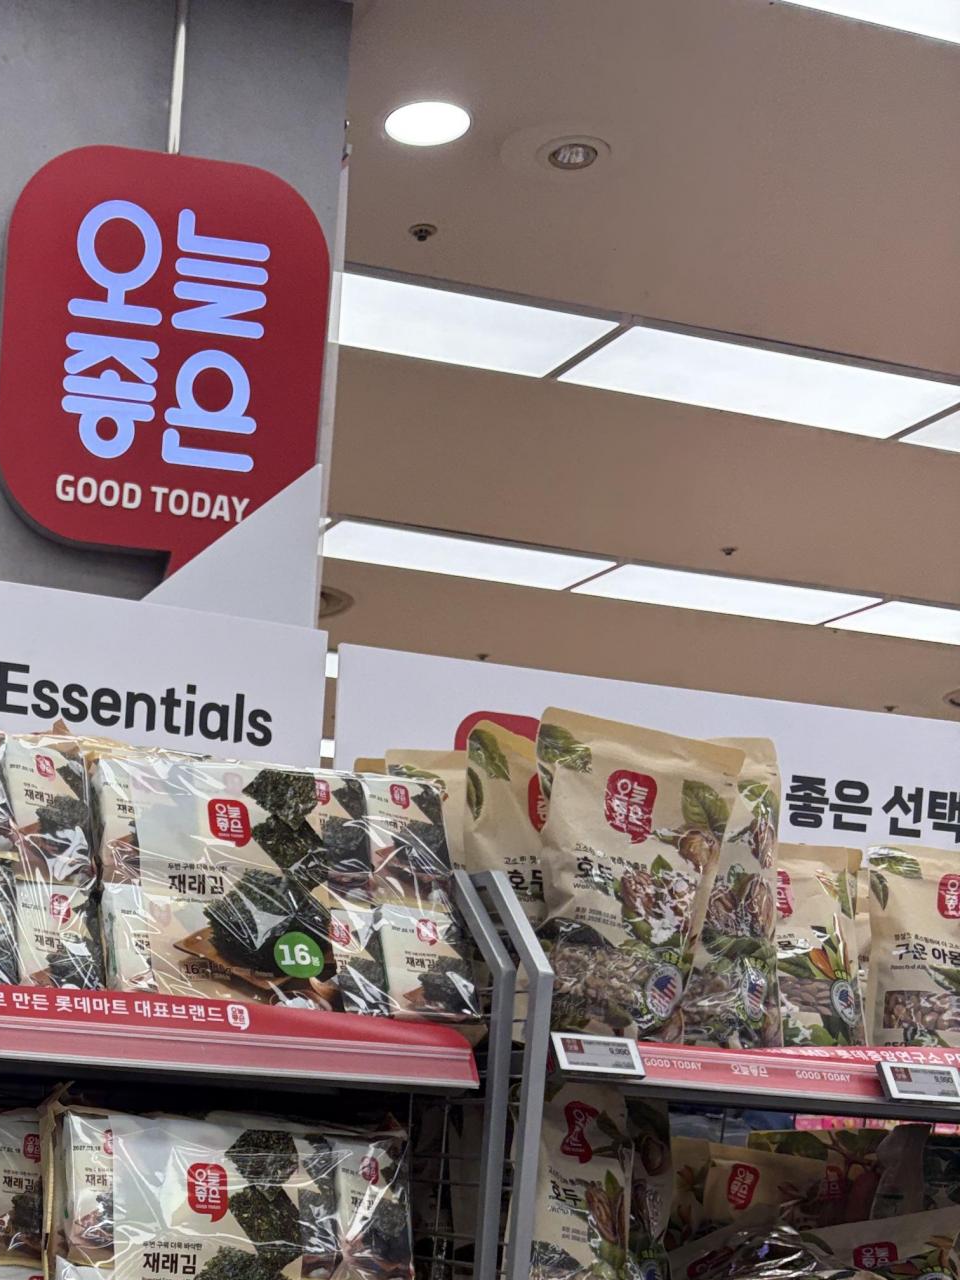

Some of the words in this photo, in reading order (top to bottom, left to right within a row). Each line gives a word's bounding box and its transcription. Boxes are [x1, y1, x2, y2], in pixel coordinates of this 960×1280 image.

[67, 200, 270, 339] 오늘
[61, 331, 257, 473] 좋은
[55, 474, 142, 510] GOOD
[151, 486, 250, 523] TODAY
[616, 779, 649, 805] 오늘
[215, 804, 244, 818] 오늘
[785, 774, 873, 832] 좋은
[882, 785, 960, 843] 선택
[214, 816, 244, 834] 좋은
[168, 875, 225, 895] 재래김
[279, 944, 320, 967] 16봉
[12, 992, 50, 1010] 만든
[54, 995, 129, 1016] 롯데마트
[135, 1000, 225, 1023] 대표브랜드
[644, 1058, 670, 1068] GOOD
[673, 1060, 702, 1071] TODAY
[795, 1070, 820, 1080] GOOD
[822, 1072, 850, 1083] TODAY
[3, 1176, 34, 1191] 재래김
[194, 1169, 221, 1184] 오늘
[194, 1183, 221, 1204] 좋은
[170, 1241, 182, 1250] 더욱
[183, 1242, 202, 1251] 바삭한
[142, 1252, 197, 1275] 재래김
